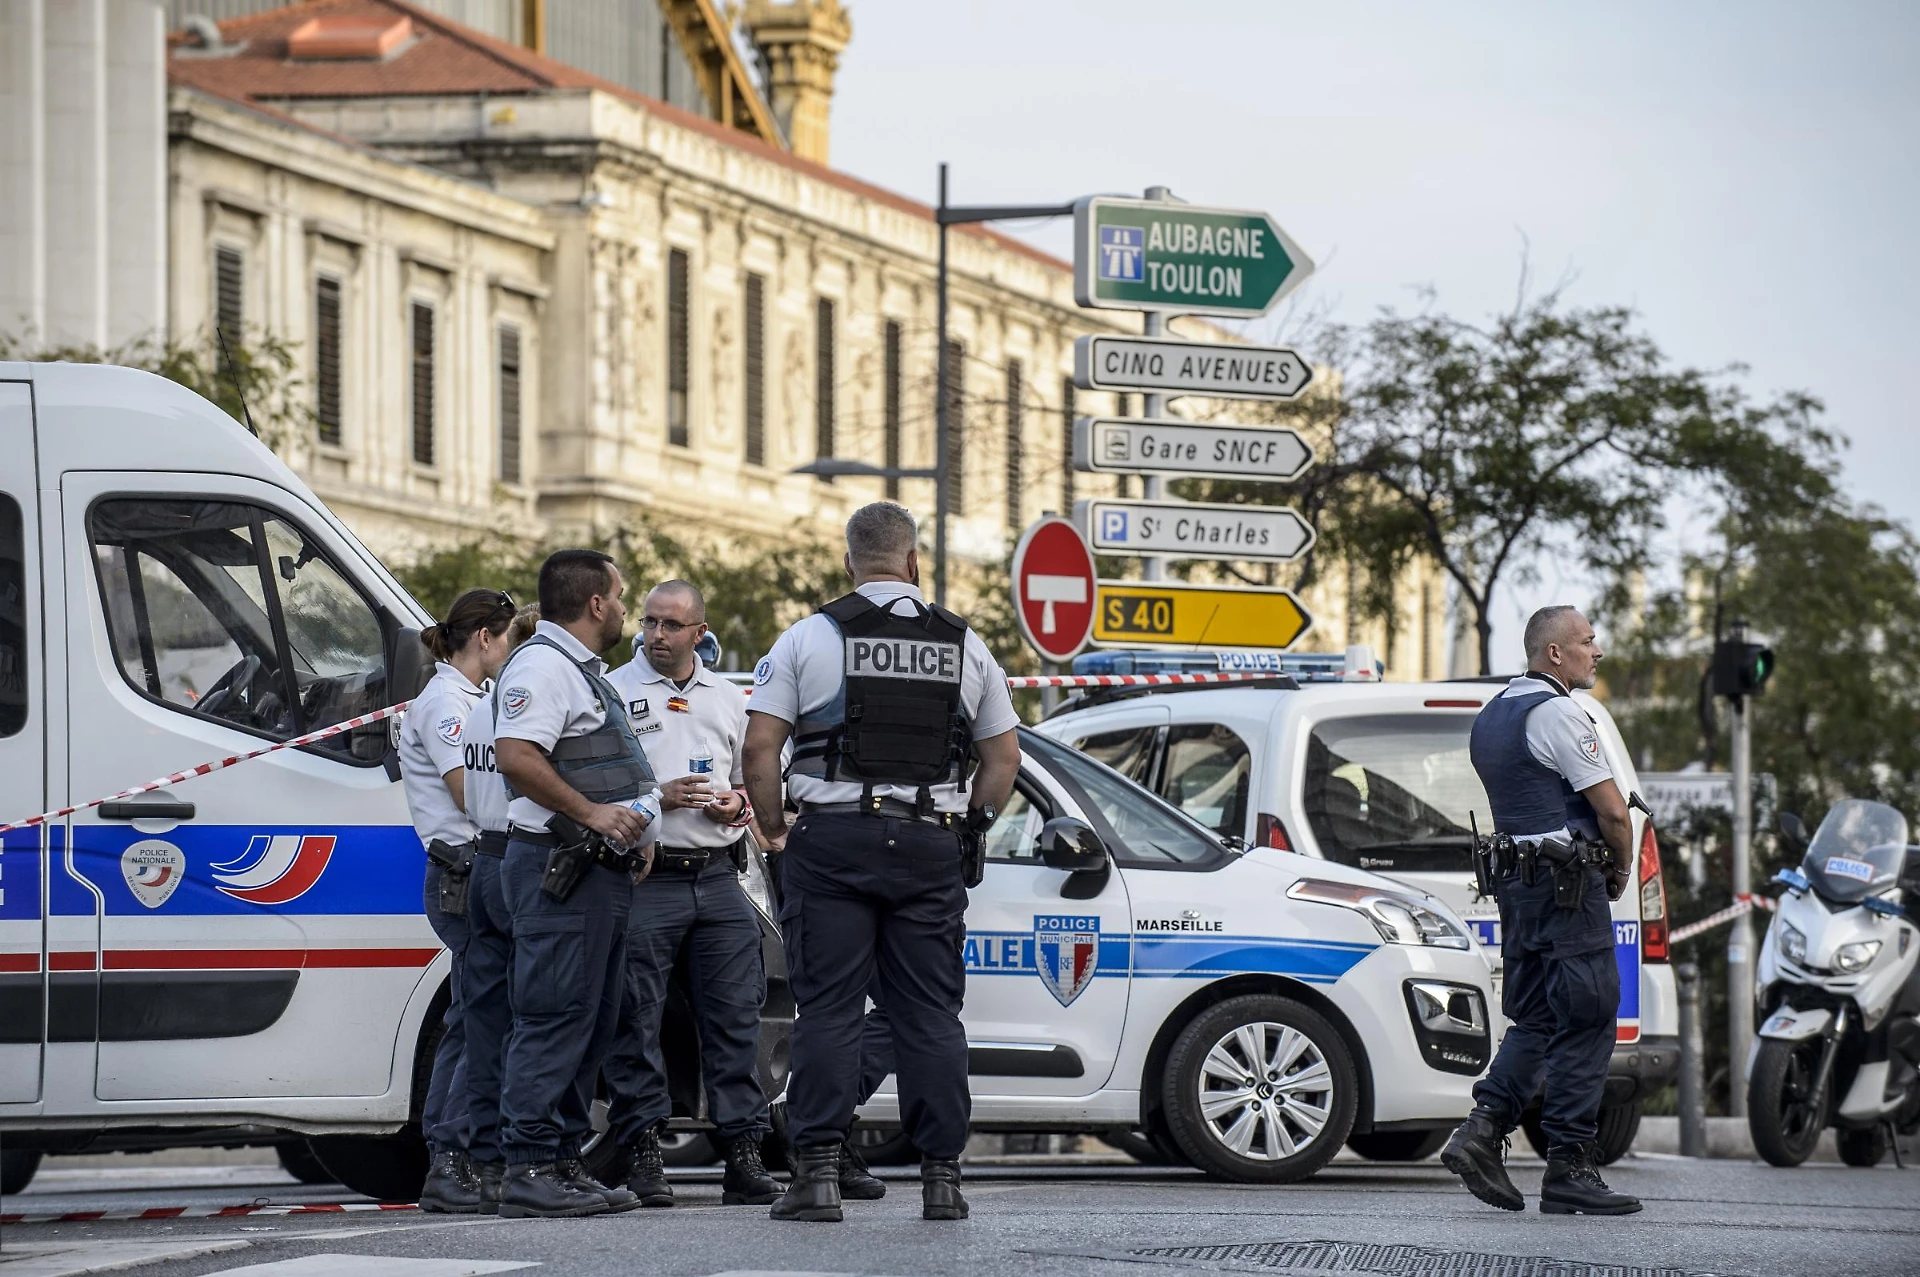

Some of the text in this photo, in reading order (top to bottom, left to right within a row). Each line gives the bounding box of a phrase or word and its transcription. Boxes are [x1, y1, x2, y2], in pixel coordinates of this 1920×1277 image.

[1148, 221, 1265, 259] AUBAGNE
[1148, 261, 1242, 297] TOULON
[1105, 351, 1292, 385] CINQ AVENUES
[1141, 435, 1278, 464] Gare SNCF
[1176, 518, 1270, 546] Charles
[1107, 598, 1171, 632] S 40
[854, 642, 954, 676] POLICE
[1220, 653, 1279, 670] POLICE
[635, 723, 661, 734] OLICE
[464, 743, 500, 774] OLIC
[1039, 918, 1095, 930] POLICE
[1136, 919, 1223, 932] MARSEILLE
[1040, 935, 1094, 944] MUNICIPALE
